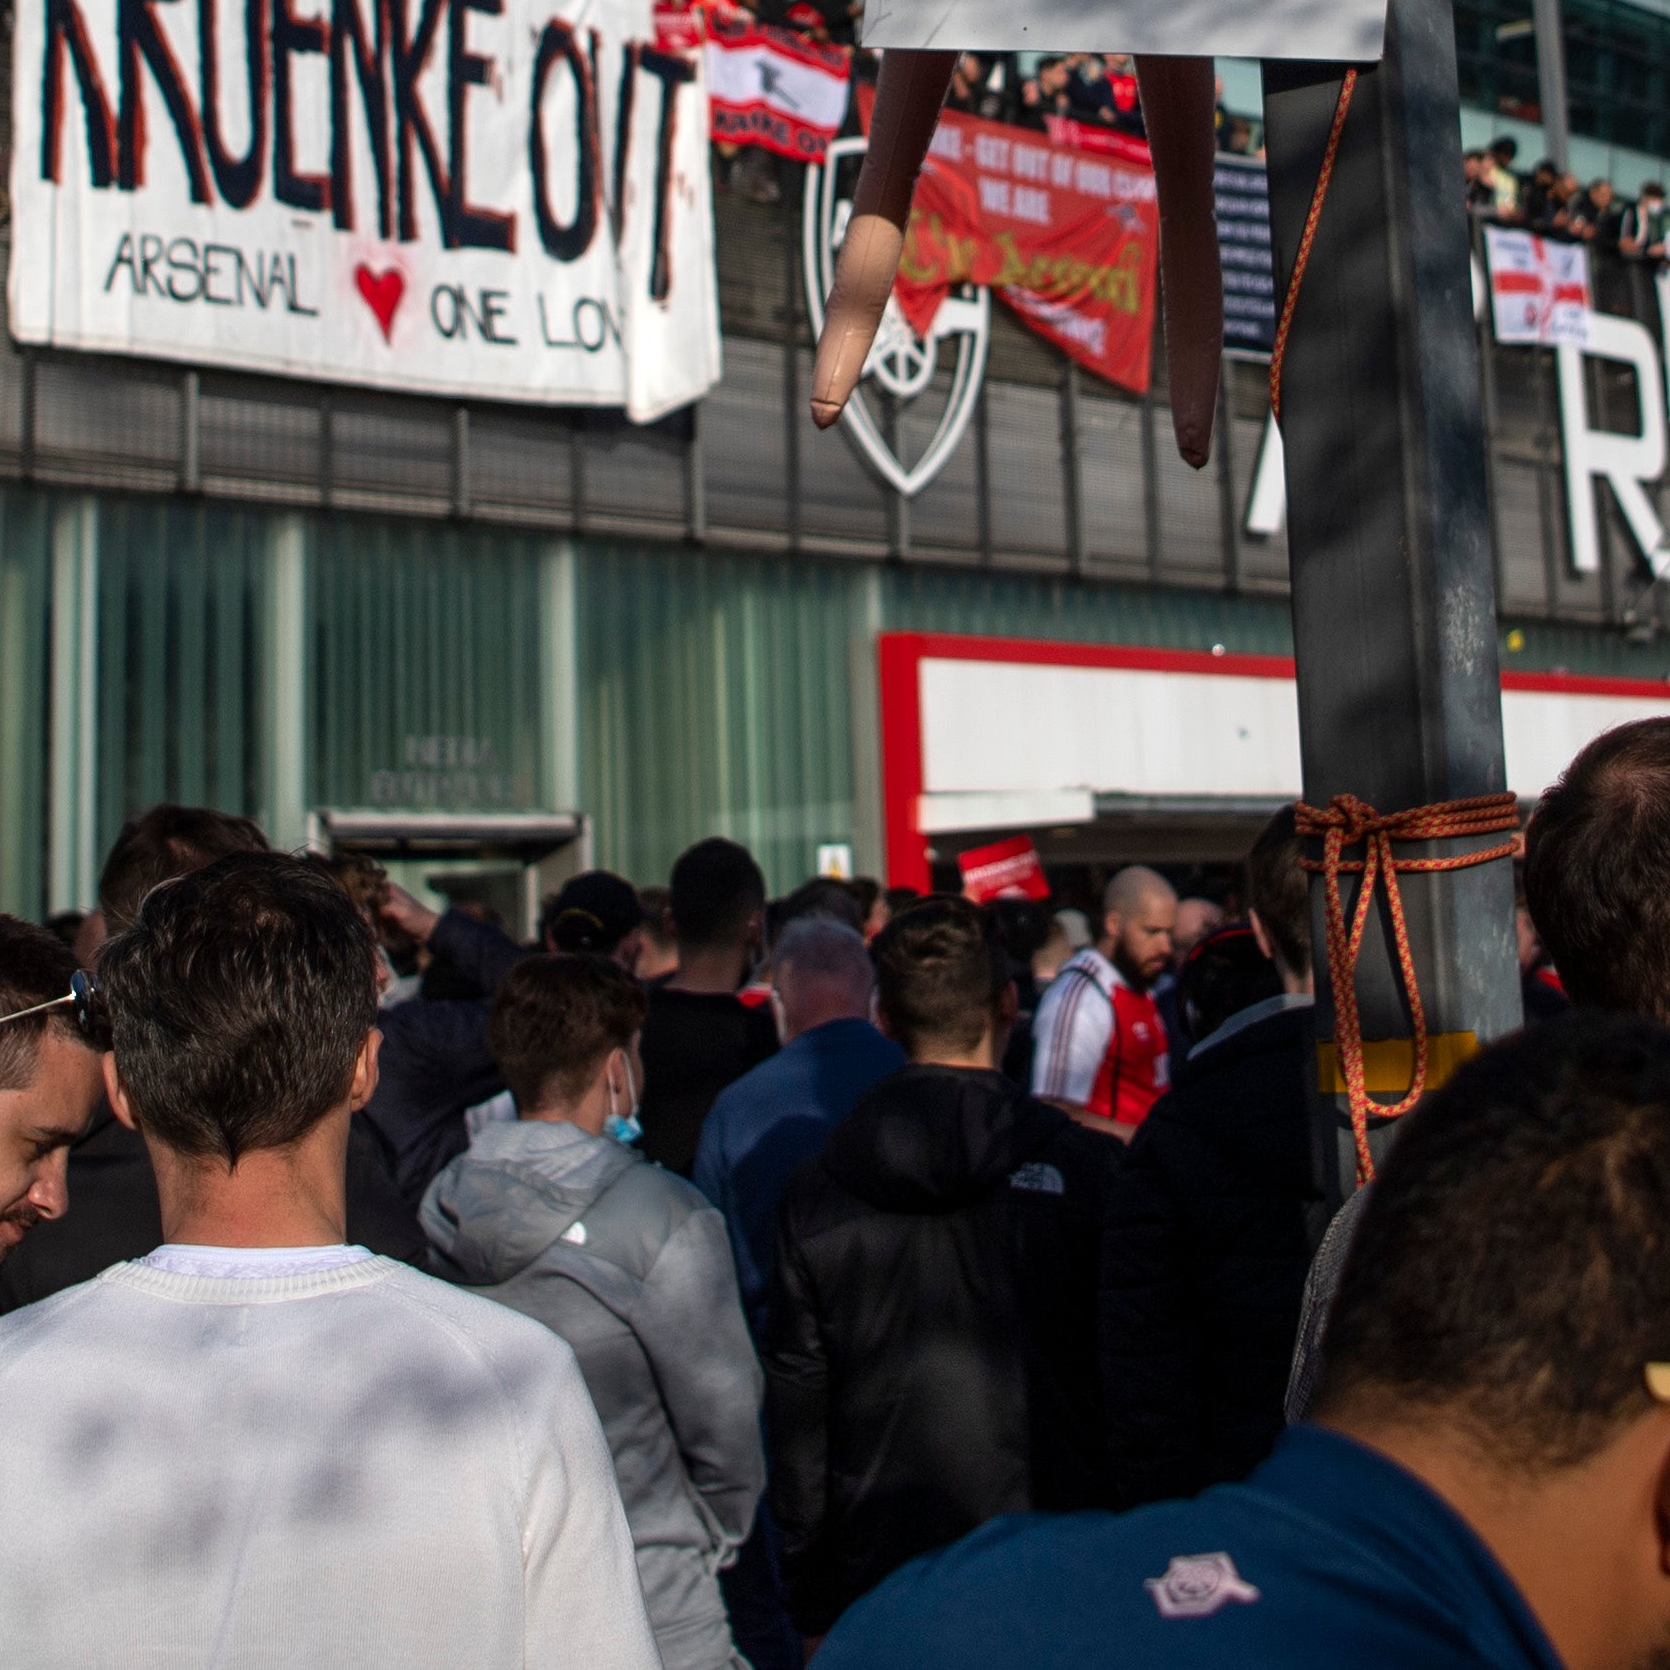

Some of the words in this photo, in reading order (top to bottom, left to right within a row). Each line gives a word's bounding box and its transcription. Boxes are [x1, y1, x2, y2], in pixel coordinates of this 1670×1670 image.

[527, 15, 697, 301] OUT
[104, 231, 319, 317] ARSENAL
[430, 283, 519, 345] ONE
